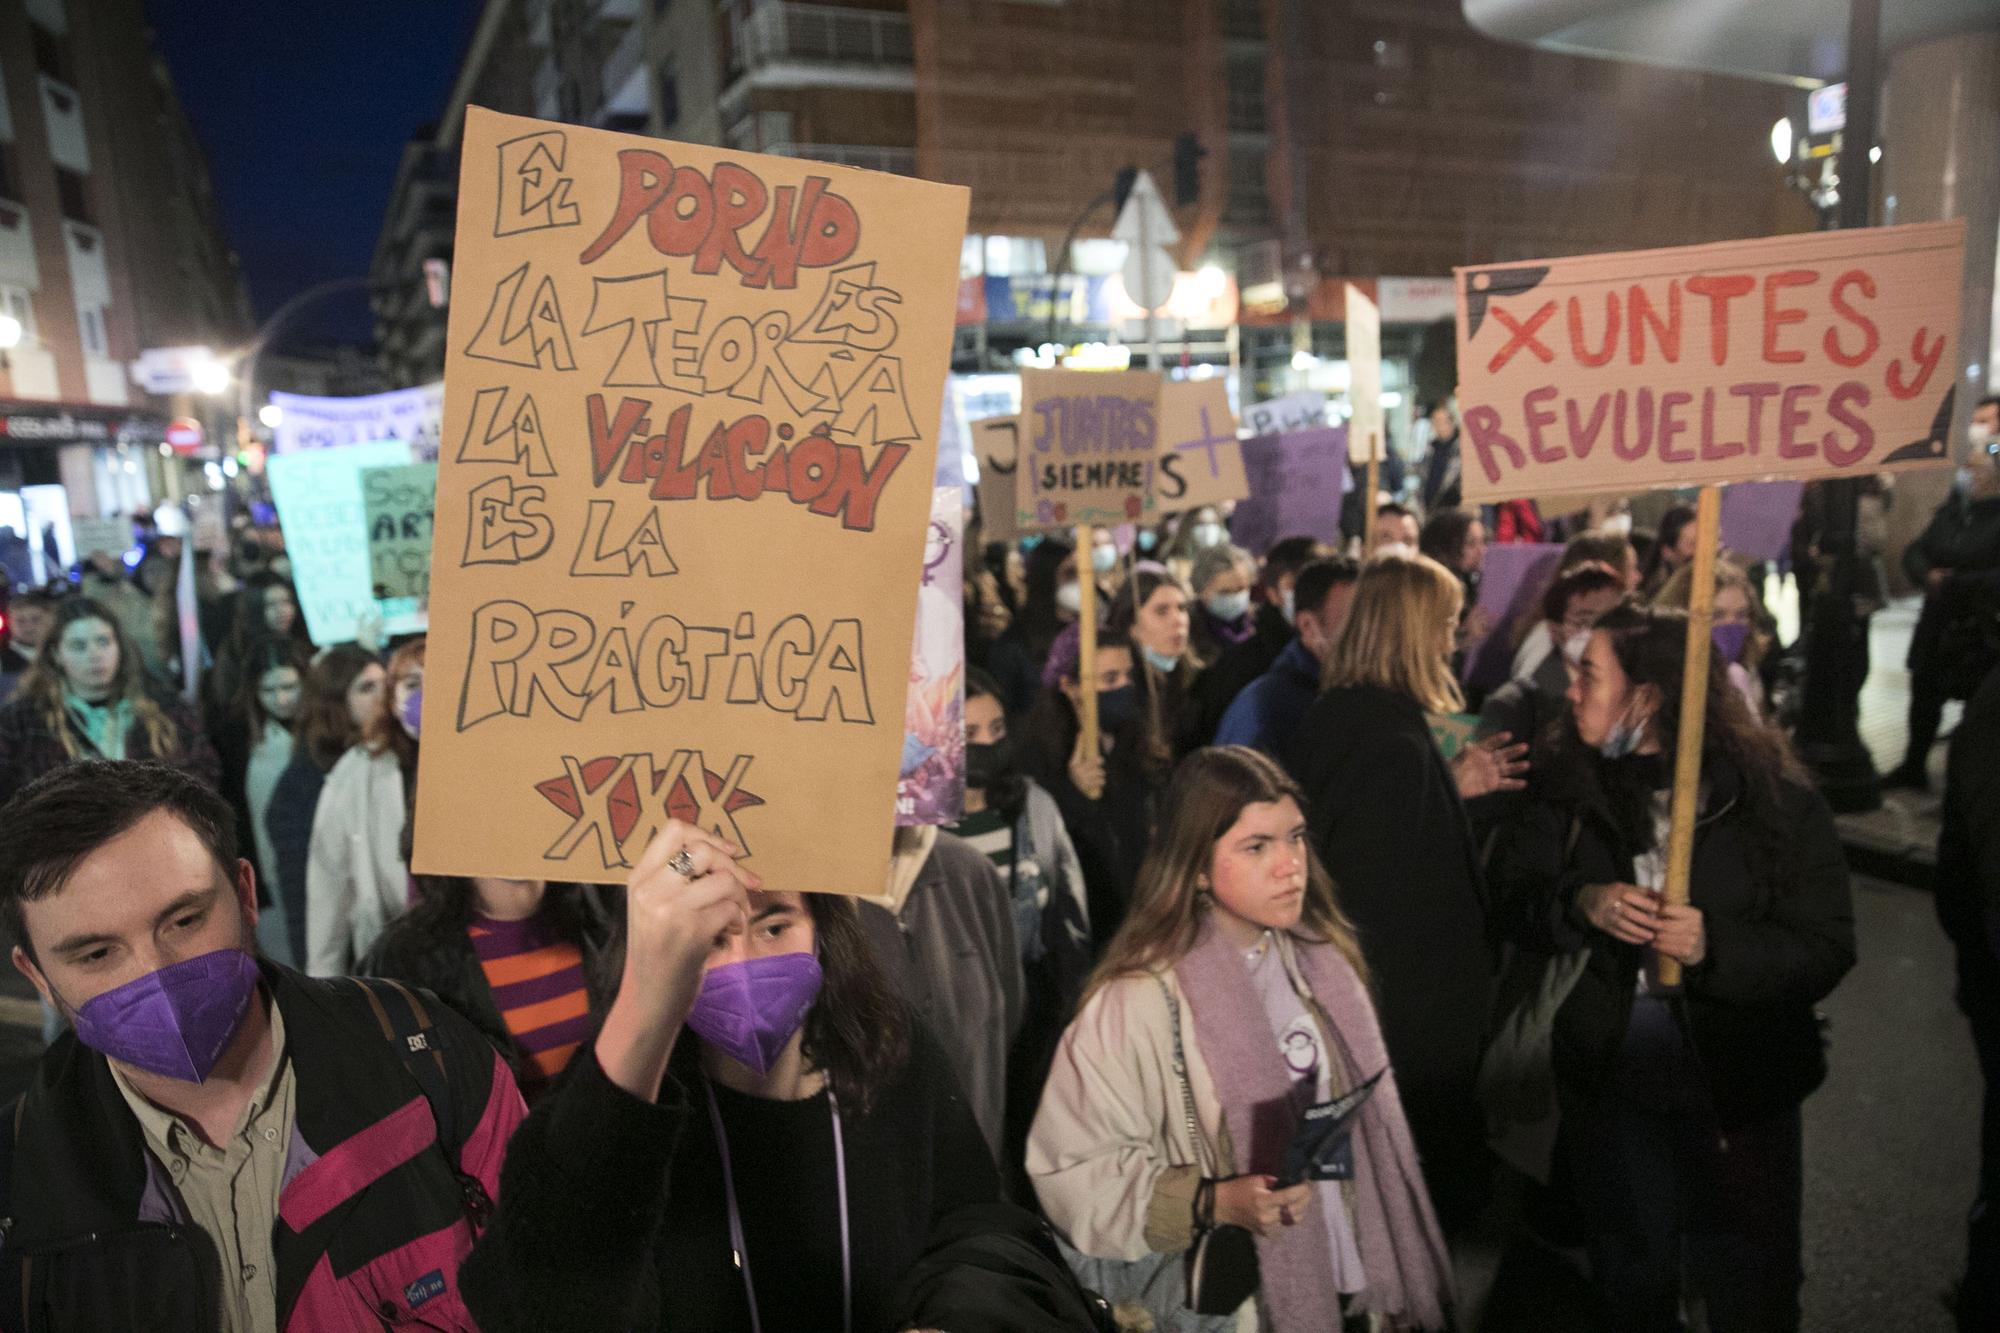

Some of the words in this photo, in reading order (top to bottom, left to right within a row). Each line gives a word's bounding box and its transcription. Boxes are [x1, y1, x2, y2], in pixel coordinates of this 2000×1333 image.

[494, 130, 580, 237] EL
[580, 149, 860, 289] PORNO
[464, 262, 577, 371] LA
[786, 260, 902, 351] ES
[1487, 269, 1879, 373] XUNTES
[456, 386, 557, 477] LA
[1042, 461, 1143, 490] SIEMPRE
[1463, 380, 1873, 484] REVUELTES
[461, 475, 554, 567] ES
[569, 499, 679, 577] LA
[543, 748, 754, 869] XXX
